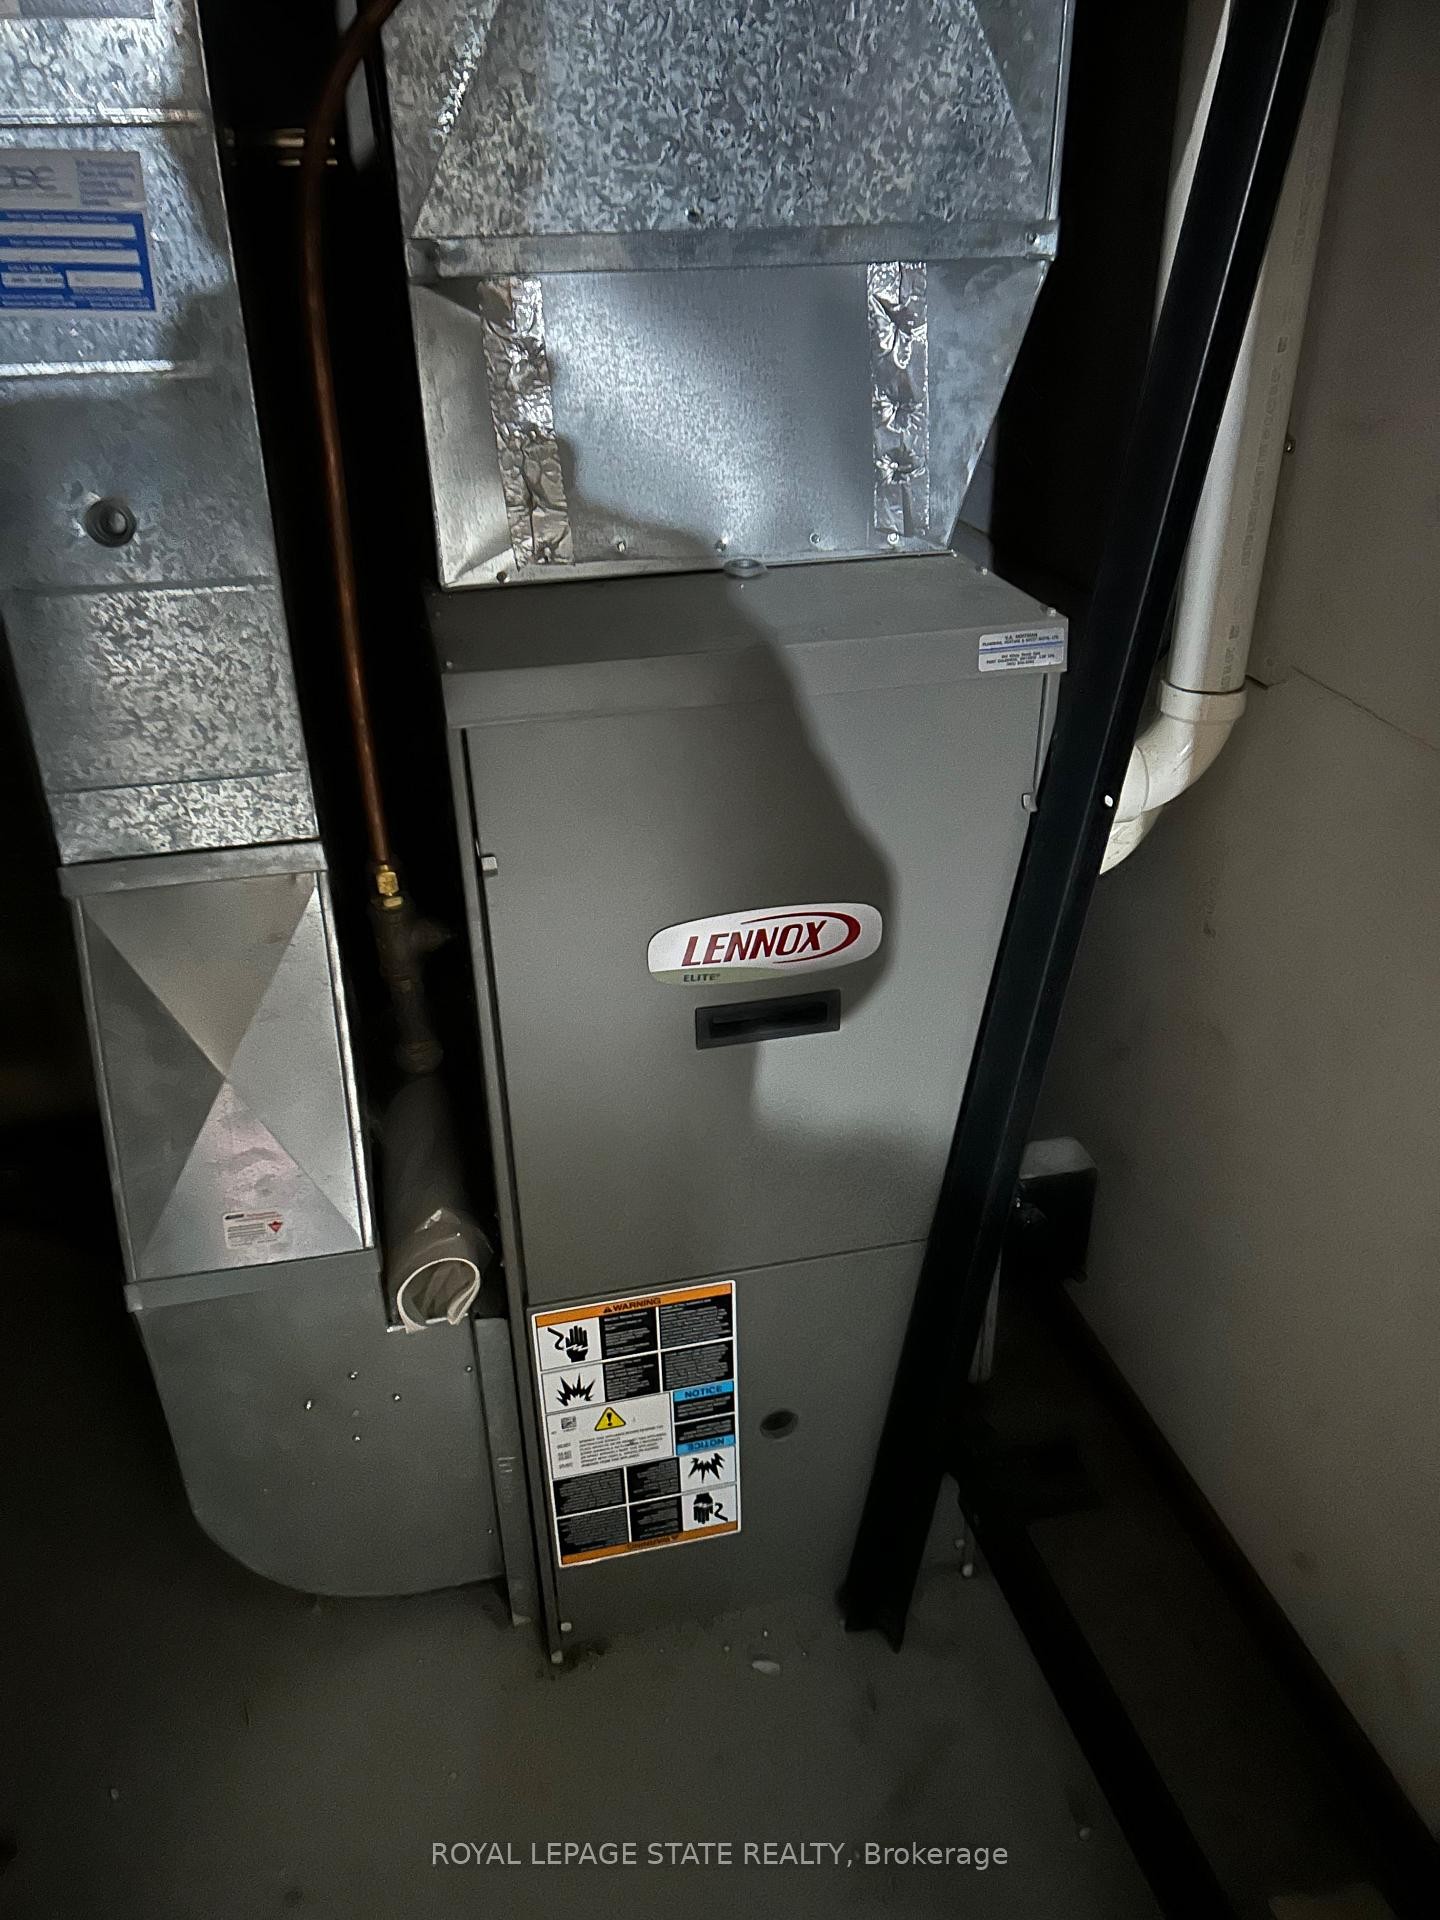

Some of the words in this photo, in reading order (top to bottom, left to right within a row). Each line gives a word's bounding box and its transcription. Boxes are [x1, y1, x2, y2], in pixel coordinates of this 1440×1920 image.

[681, 919, 828, 967] LENNOX
[613, 1298, 661, 1311] WARNING
[685, 1385, 723, 1398] NOTICE
